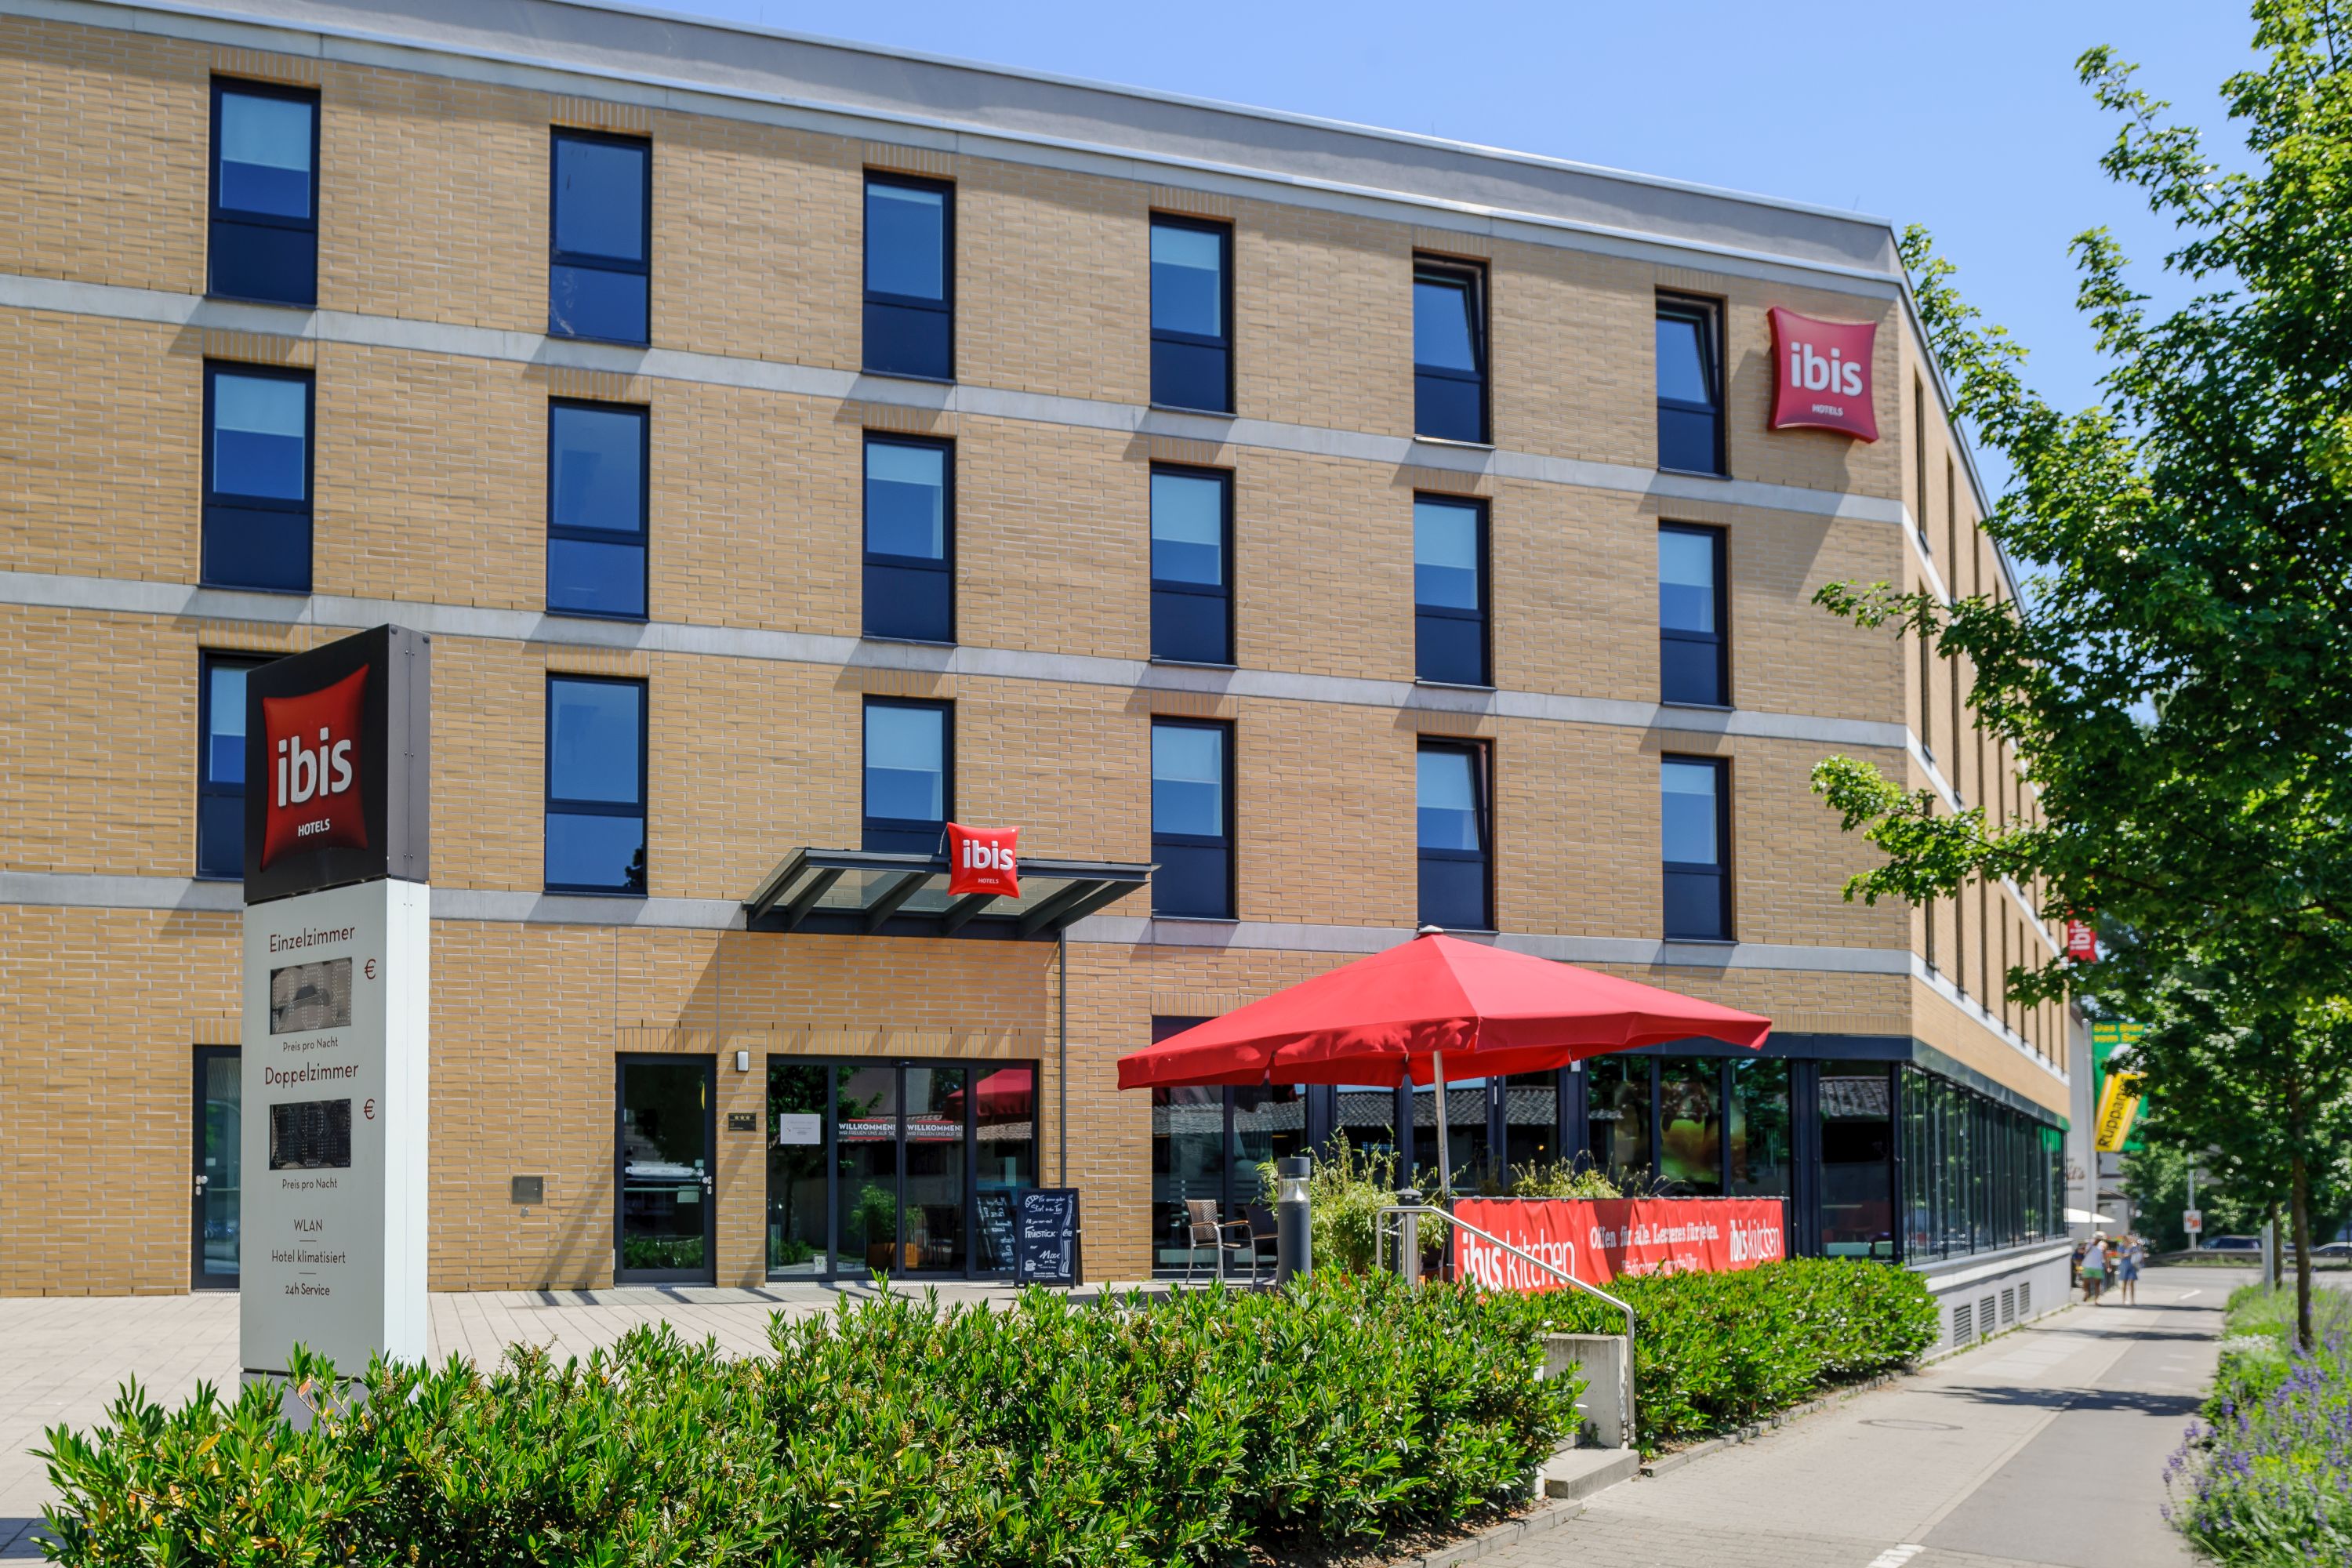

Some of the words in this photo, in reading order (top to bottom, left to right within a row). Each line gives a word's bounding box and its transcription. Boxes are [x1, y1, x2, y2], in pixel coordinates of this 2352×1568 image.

[1791, 341, 1863, 397] ibis
[1812, 404, 1844, 416] HOTELS
[278, 727, 353, 808] ibis
[297, 818, 330, 837] HOTELS
[963, 839, 1014, 870] ibis
[270, 927, 355, 953] Einzelzimmer
[283, 1040, 300, 1052] Preis
[302, 1040, 314, 1053] pro
[317, 1036, 338, 1049] Nacht
[265, 1062, 359, 1088] Doppelzimmer
[282, 1178, 299, 1189] Preis
[301, 1180, 314, 1192] pro
[316, 1178, 337, 1189] Nacht
[293, 1219, 323, 1232] WLAN
[271, 1250, 295, 1262] Hotel
[296, 1250, 346, 1264] klimatisiert
[285, 1283, 299, 1295] 24h
[301, 1283, 330, 1296] Service
